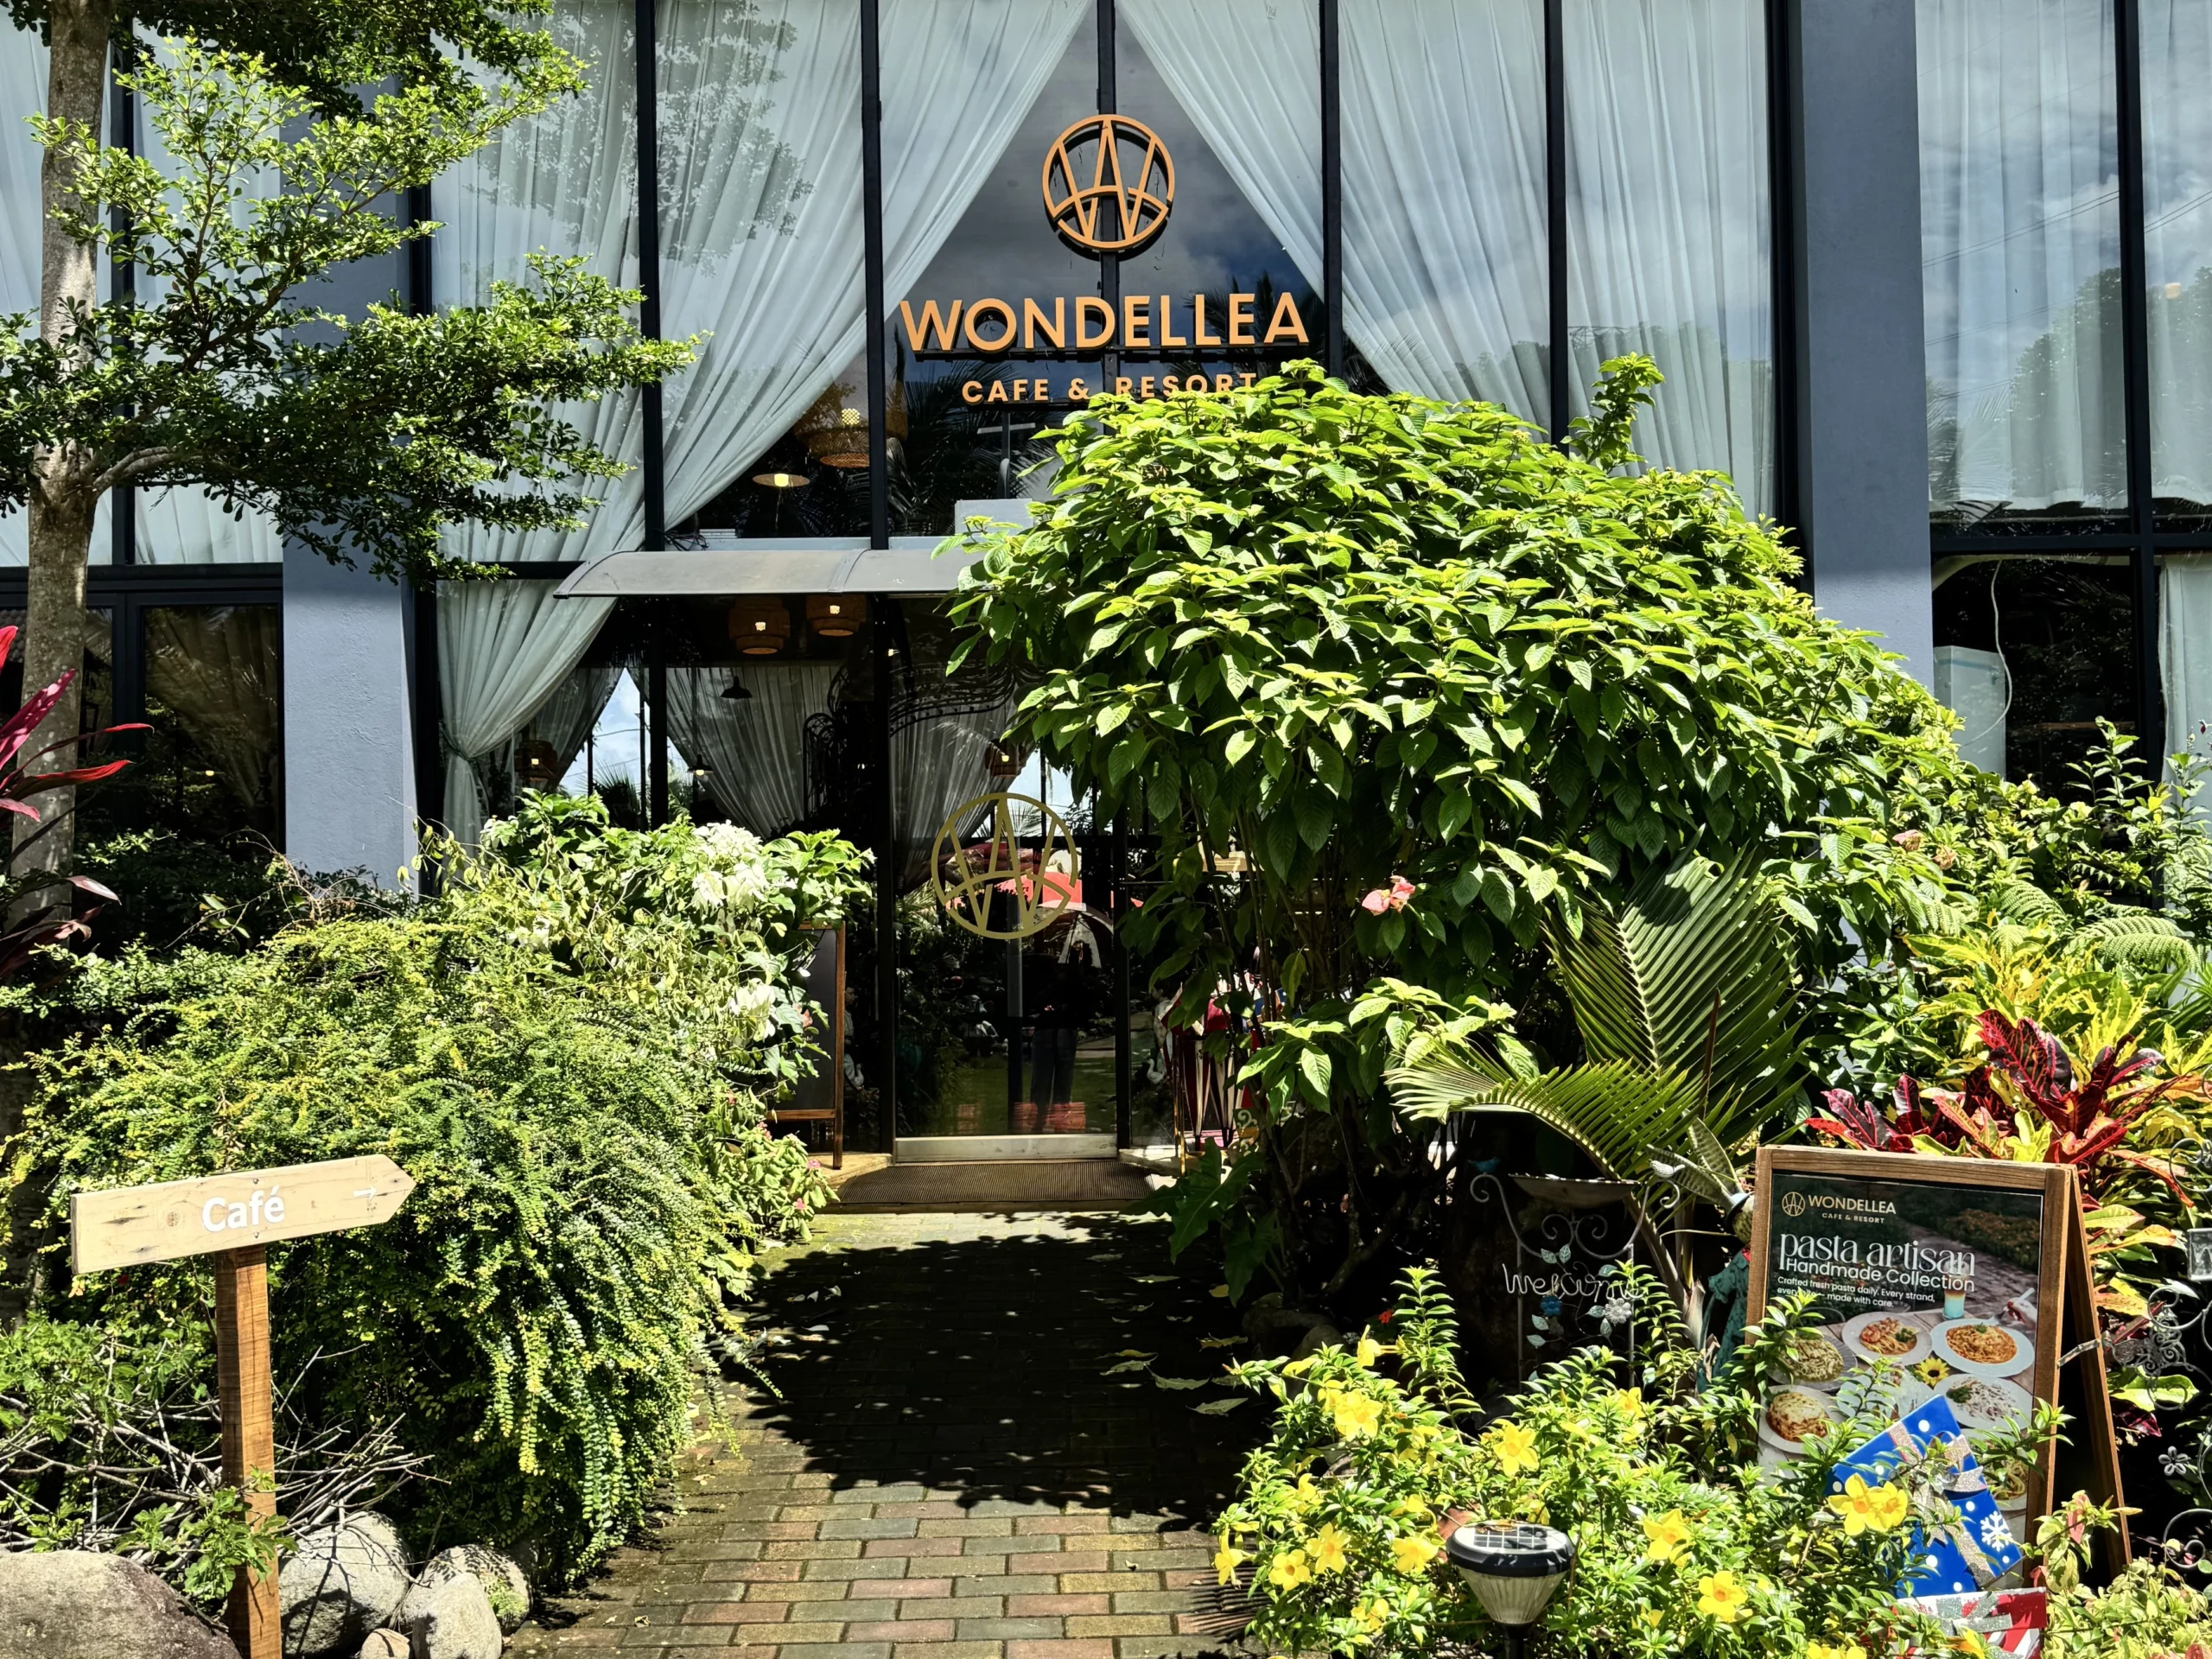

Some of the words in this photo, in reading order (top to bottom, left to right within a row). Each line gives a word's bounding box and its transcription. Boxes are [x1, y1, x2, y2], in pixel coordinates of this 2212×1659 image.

[900, 292, 1309, 351] WONDELLEA
[962, 378, 1048, 403] CAFE
[1068, 378, 1090, 401] &
[1116, 372, 1256, 398] RESORT
[201, 1185, 285, 1233] Café
[1808, 1194, 1897, 1215] WONDELLEA
[1853, 1215, 1885, 1224] RESORT
[1779, 1233, 1858, 1270] pasta
[1866, 1240, 1975, 1277] artisan
[1777, 1275, 1808, 1287] Crafted
[1810, 1279, 1830, 1289] fresh
[1831, 1282, 1856, 1293] pasta
[1857, 1286, 1879, 1297] daily.
[1881, 1287, 1904, 1300] Every
[1905, 1292, 1936, 1303] strand,
[1786, 1257, 1882, 1281] Handmade
[1886, 1268, 1975, 1293] Collection
[1827, 1293, 1852, 1302] made
[1853, 1296, 1871, 1306] with
[1872, 1299, 1894, 1308] care.
